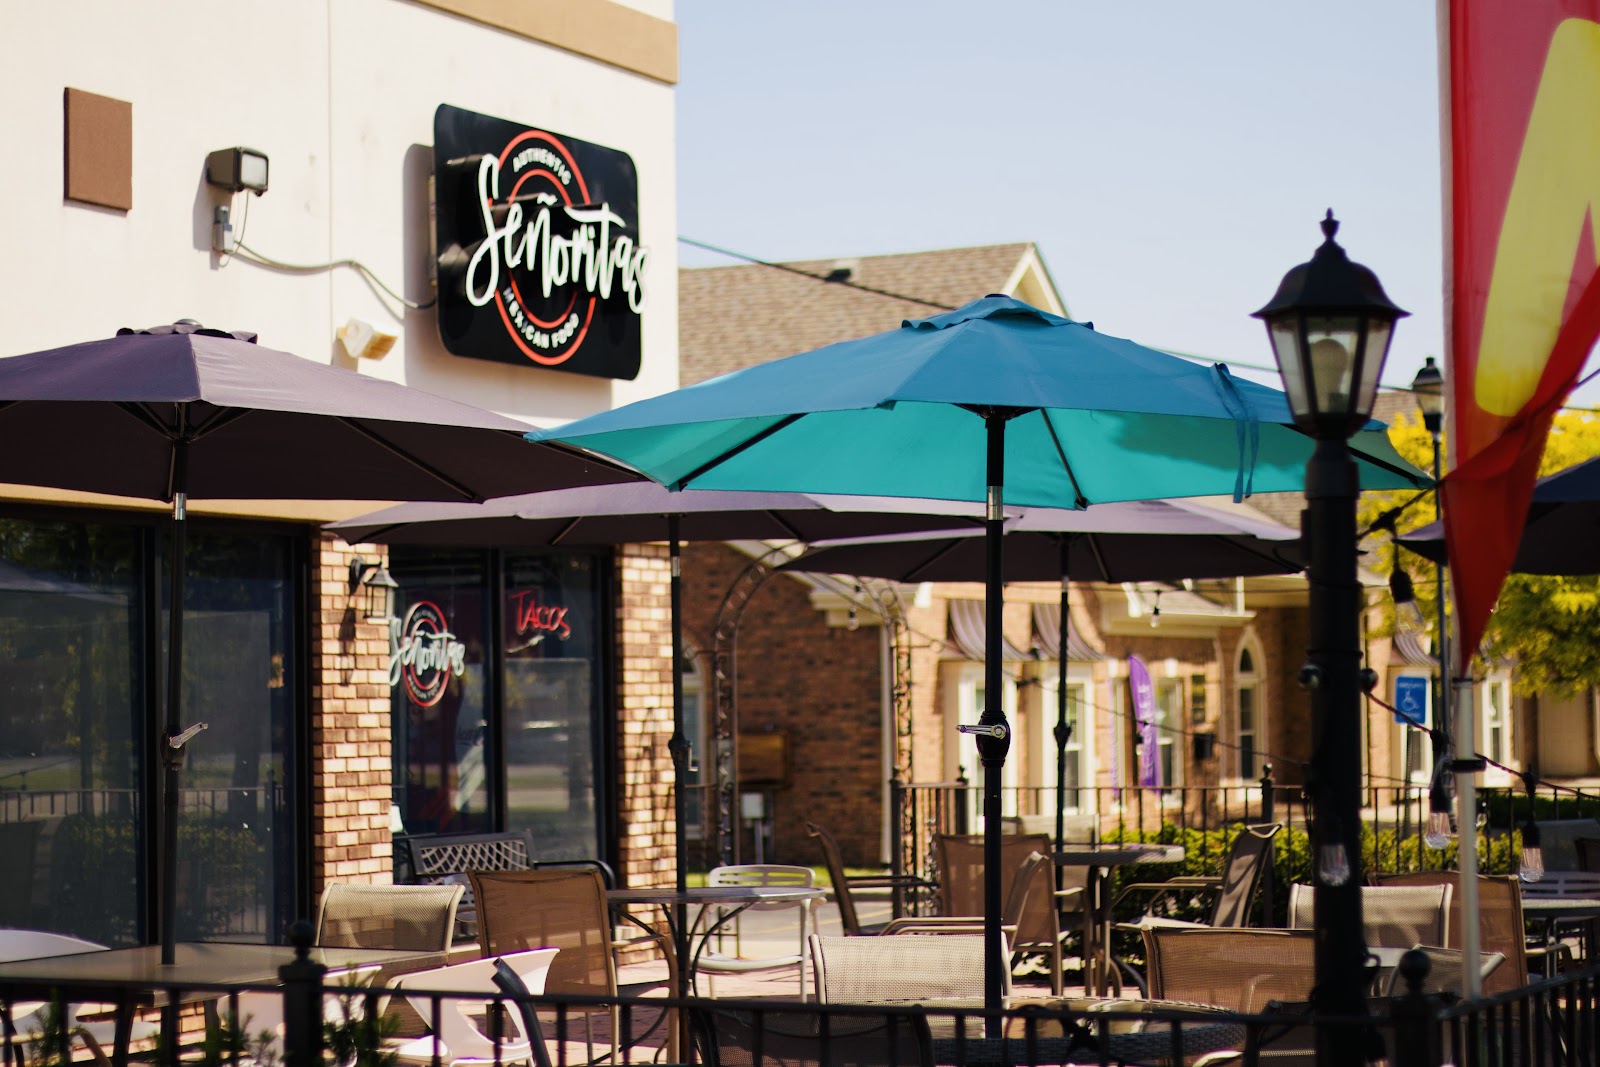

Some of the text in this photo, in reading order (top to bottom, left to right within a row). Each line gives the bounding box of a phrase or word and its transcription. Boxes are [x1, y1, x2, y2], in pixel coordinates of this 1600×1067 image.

[513, 148, 571, 185] AUTHENTIC
[466, 153, 648, 313] Señoritas
[503, 287, 579, 349] MEXICAN FOOD
